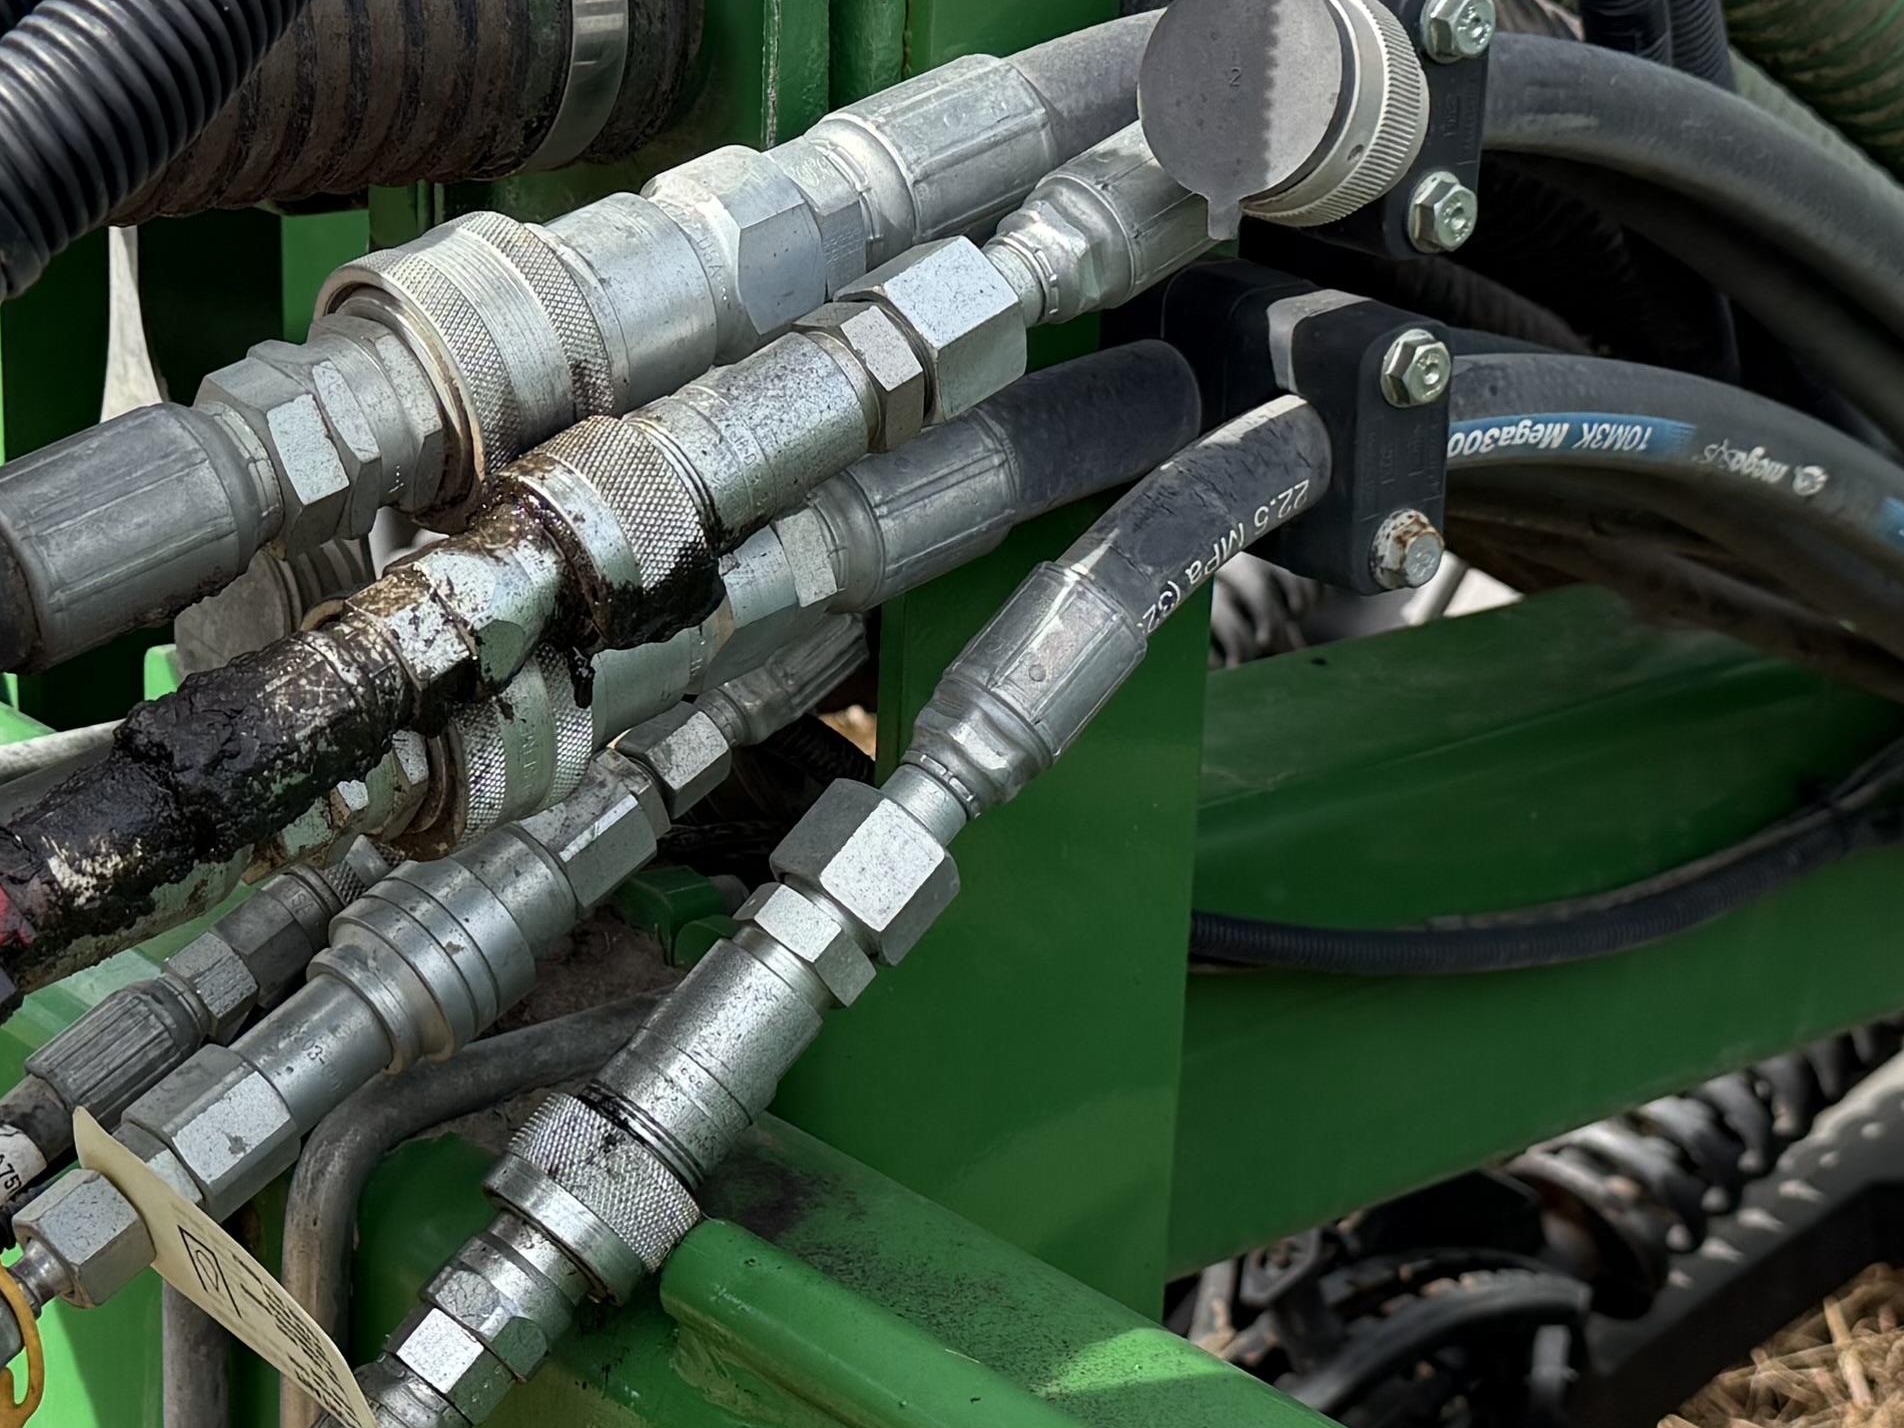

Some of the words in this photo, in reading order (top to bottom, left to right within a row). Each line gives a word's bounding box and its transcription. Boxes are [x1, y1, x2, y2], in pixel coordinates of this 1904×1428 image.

[1570, 421, 1653, 451] 10M3K
[1245, 476, 1315, 536] 22.5
[1182, 521, 1249, 586] MPa
[1134, 580, 1182, 637] (32
